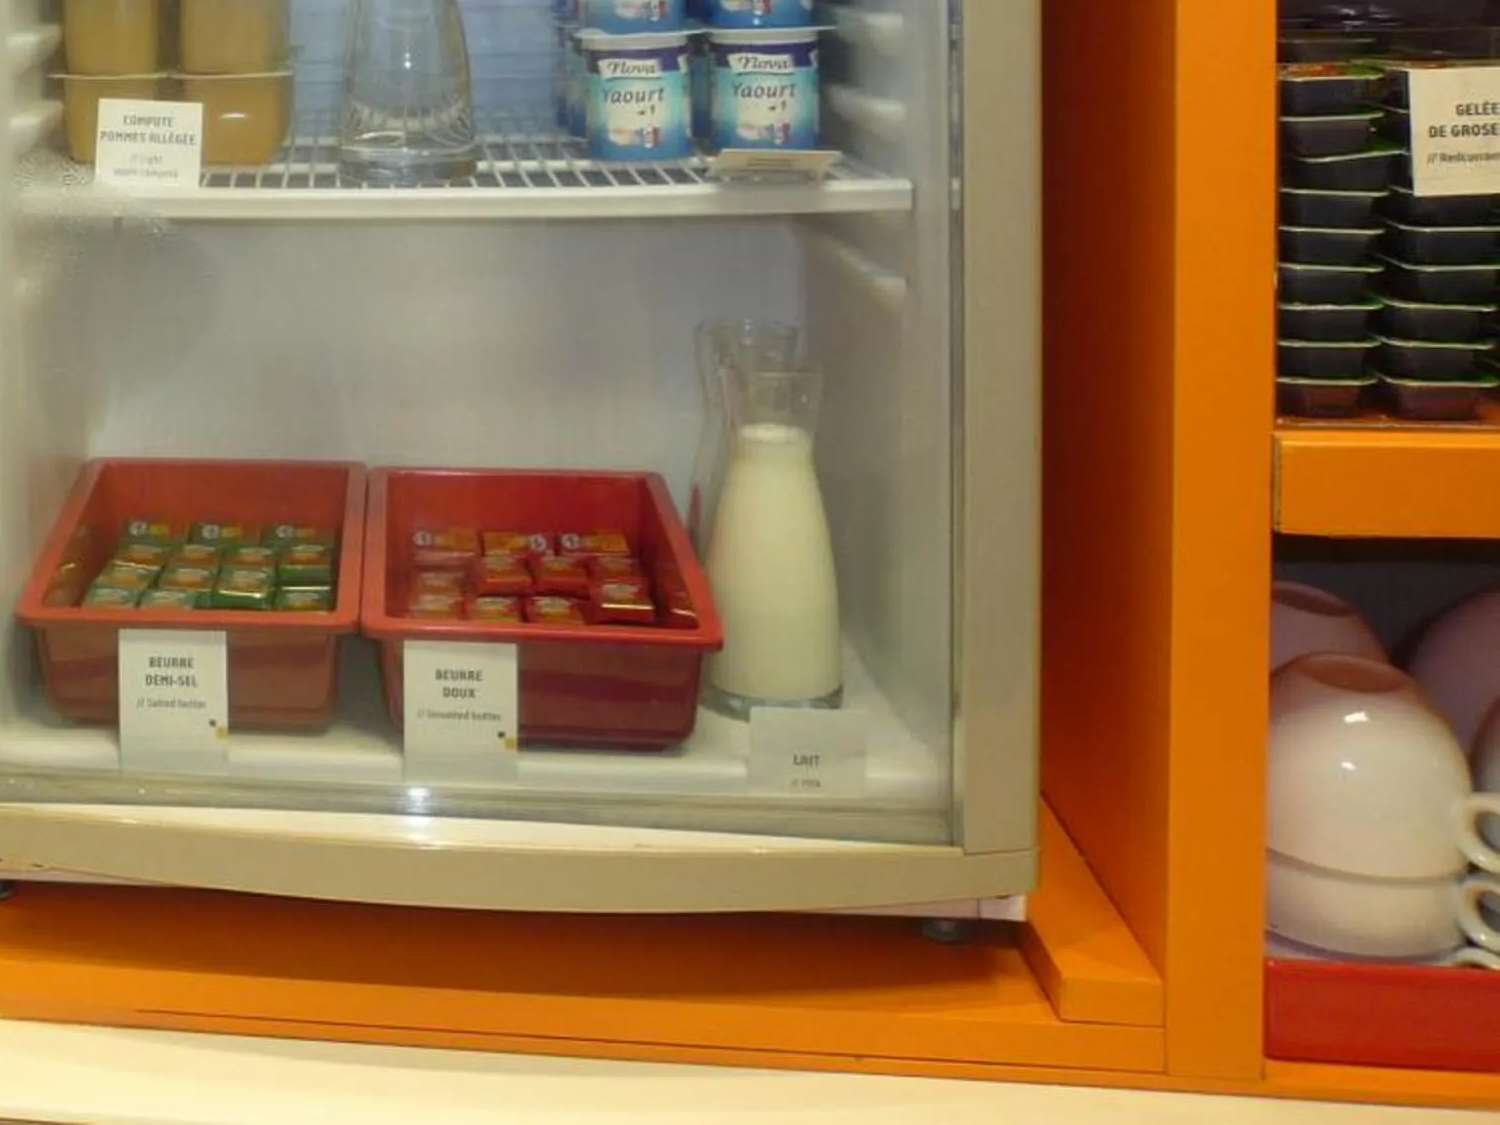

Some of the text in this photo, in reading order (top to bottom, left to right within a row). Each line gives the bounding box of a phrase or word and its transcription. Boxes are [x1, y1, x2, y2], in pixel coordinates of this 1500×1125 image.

[607, 61, 657, 75] Nova
[738, 55, 790, 69] Nova
[602, 87, 664, 104] Yaourt
[732, 82, 796, 98] Yaourt
[1455, 100, 1500, 116] GELÉE
[123, 114, 174, 127] COMPOTE
[100, 130, 147, 143] POMMES
[1428, 125, 1447, 137] DE
[148, 657, 194, 668] BEURRE
[145, 674, 198, 687] DEMI-SEL
[435, 669, 483, 681] BEURRE
[443, 686, 476, 698] DOUX
[793, 752, 821, 765] LAIT
